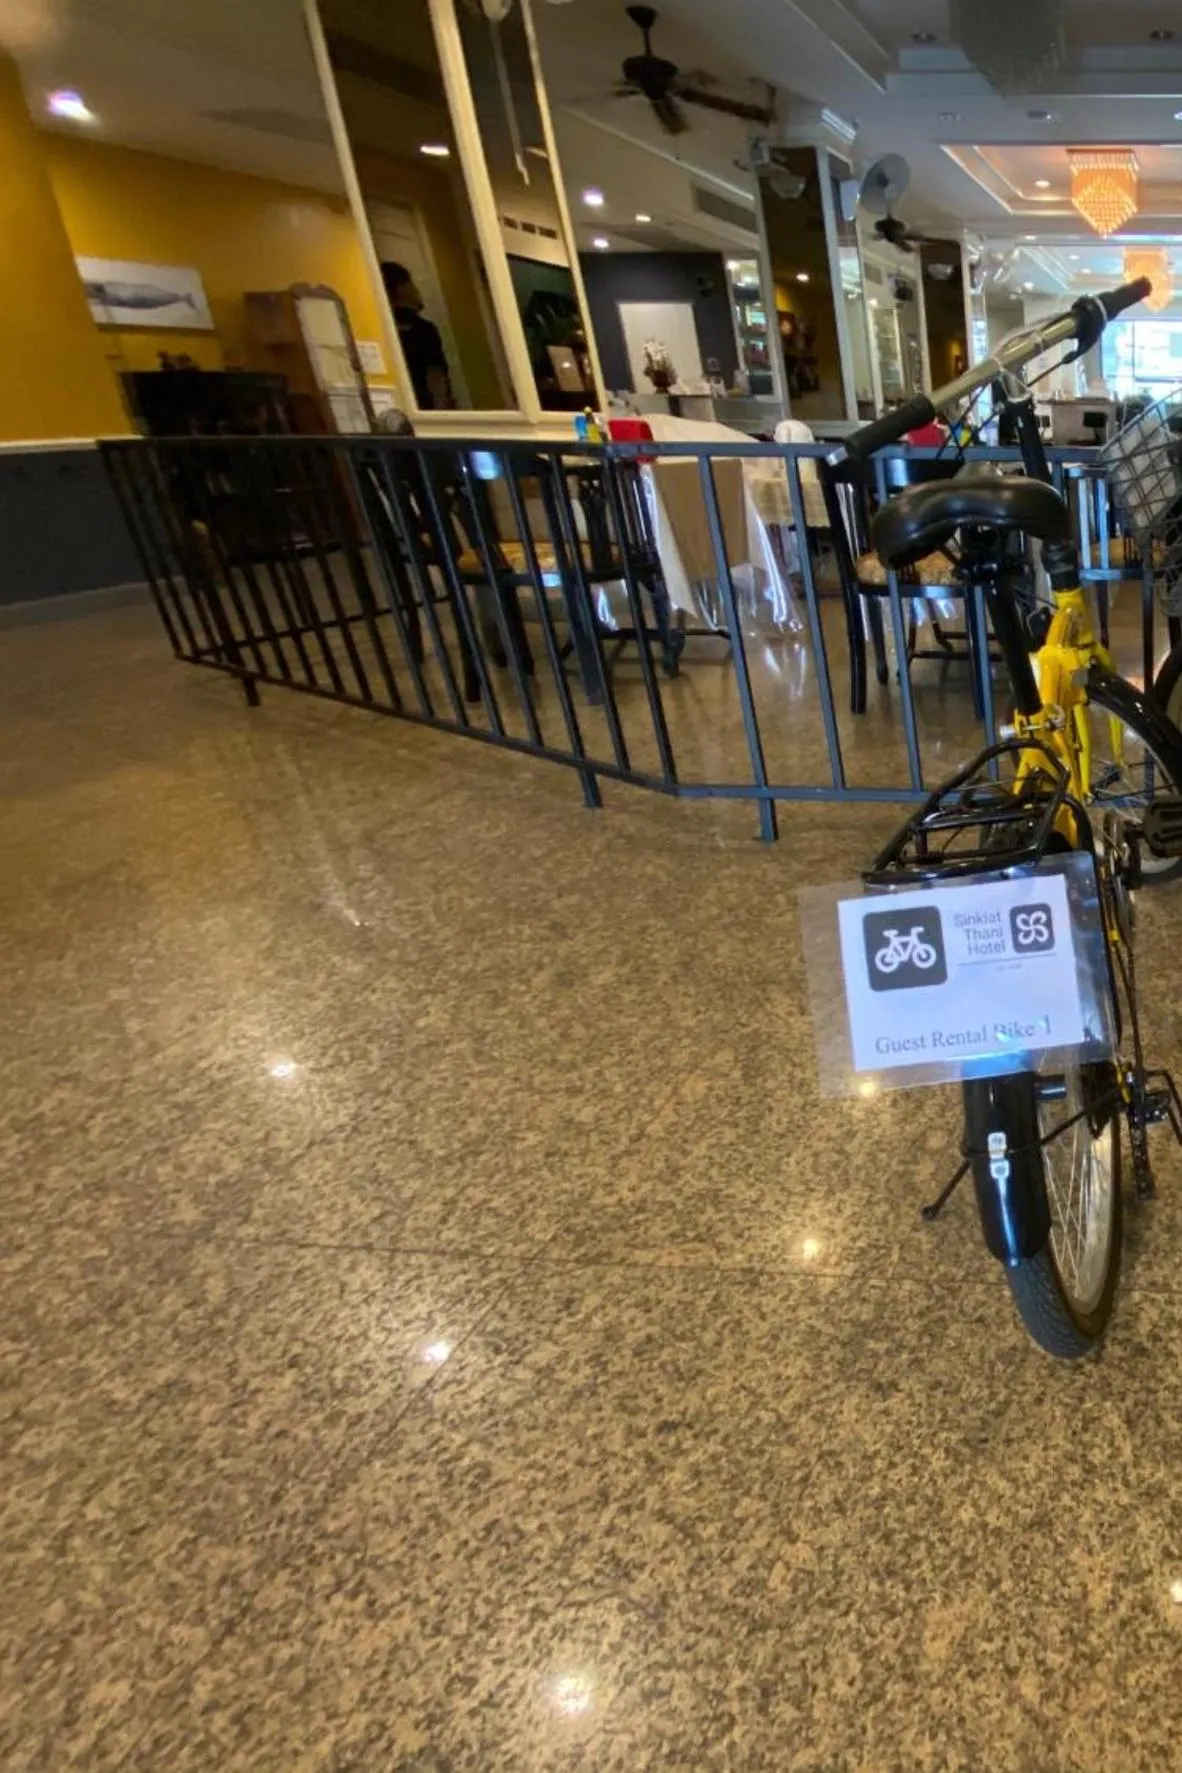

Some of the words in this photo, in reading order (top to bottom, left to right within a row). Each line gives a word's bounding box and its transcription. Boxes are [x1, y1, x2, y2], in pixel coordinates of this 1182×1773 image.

[954, 910, 1001, 928] Sinkiat
[963, 926, 1003, 941] Thani
[967, 939, 1006, 957] Hotel
[875, 1034, 926, 1054] Guest
[931, 1025, 987, 1048] Rental
[993, 1022, 1035, 1042] Bike
